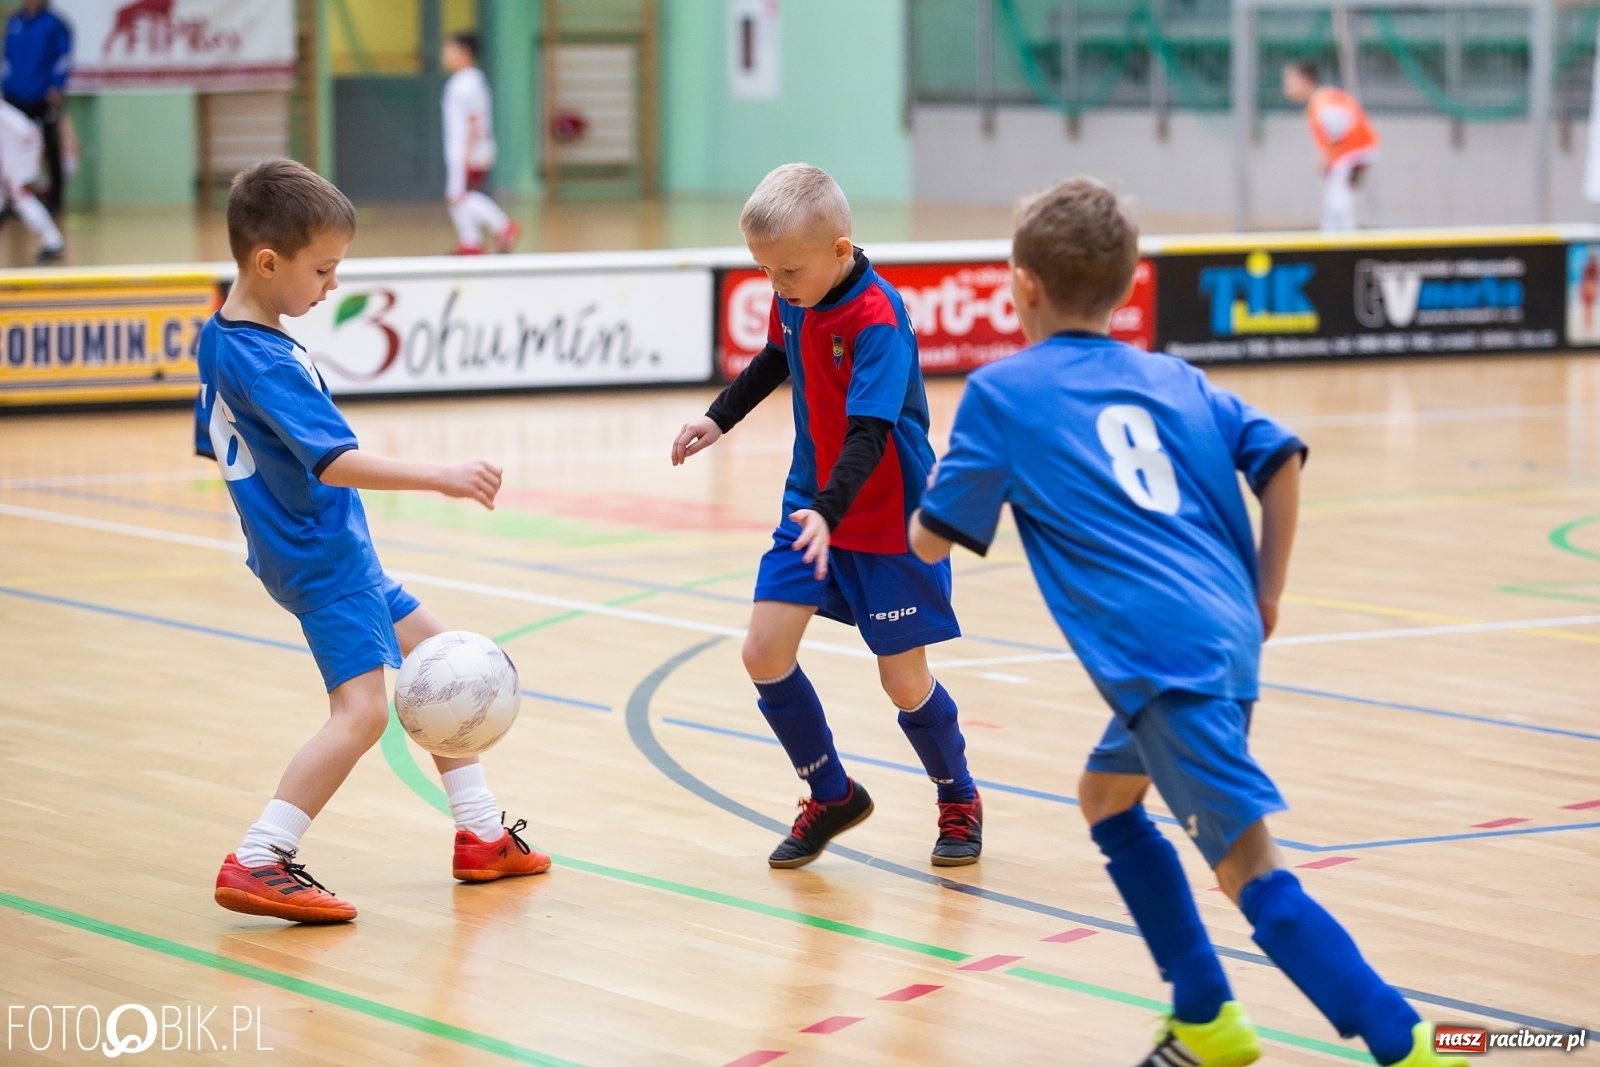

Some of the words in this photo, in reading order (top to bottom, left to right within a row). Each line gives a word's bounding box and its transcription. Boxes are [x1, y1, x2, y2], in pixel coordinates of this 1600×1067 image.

[0, 318, 200, 368] OHUMIN.CZ
[209, 391, 256, 481] 6
[1097, 404, 1180, 516] 8
[869, 606, 917, 621] regio
